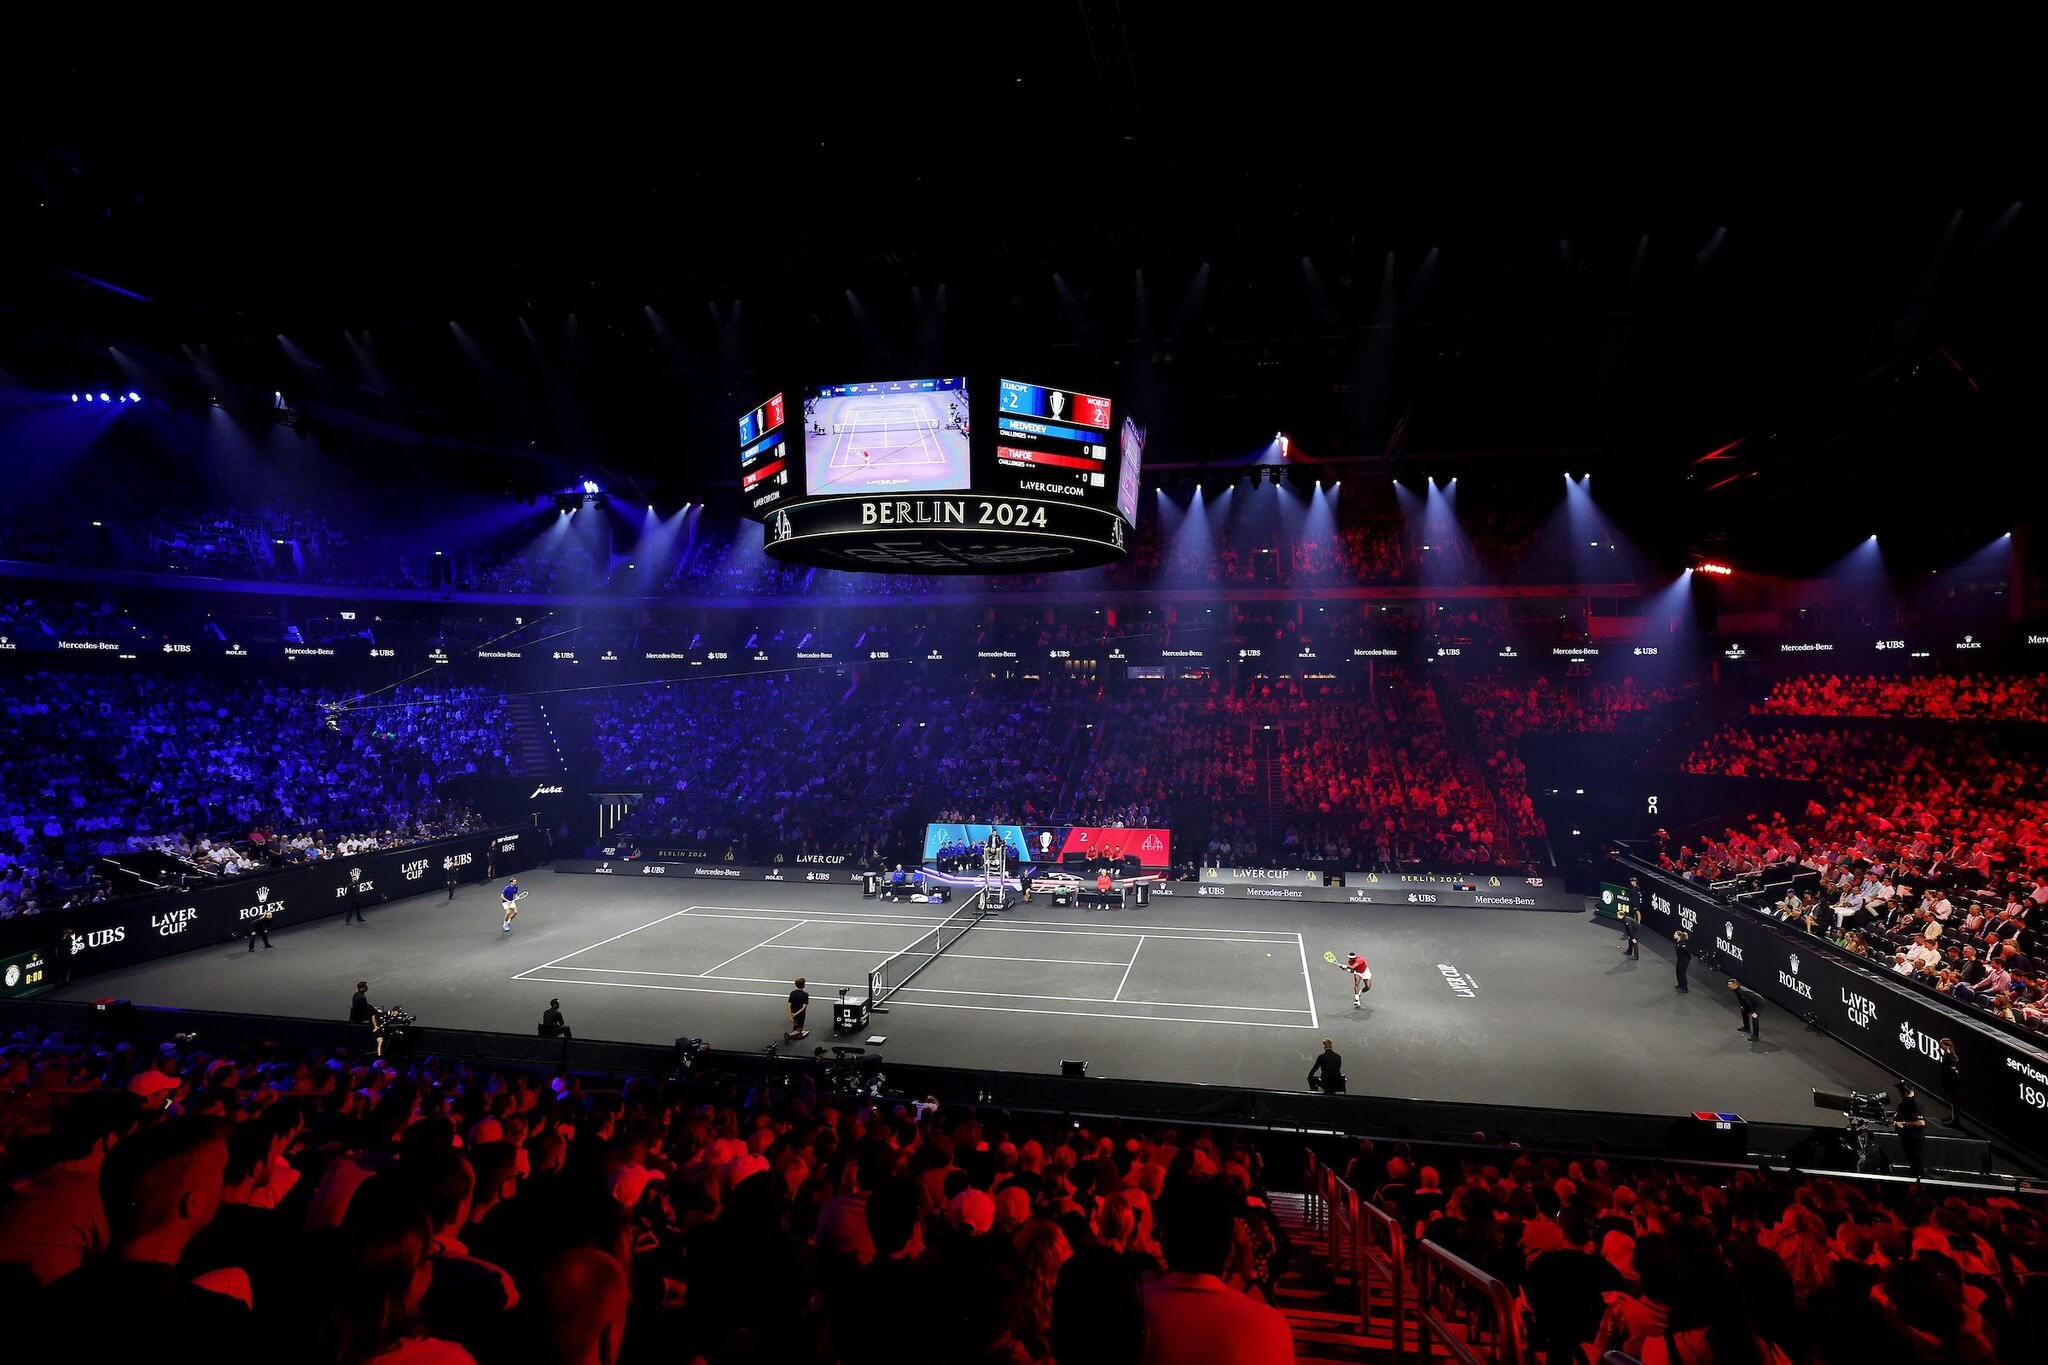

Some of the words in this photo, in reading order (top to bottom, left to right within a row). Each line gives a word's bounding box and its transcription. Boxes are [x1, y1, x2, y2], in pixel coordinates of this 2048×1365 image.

[1002, 382, 1028, 393] EUROPE
[1009, 393, 1019, 408] 2
[1087, 398, 1110, 407] WORLD
[1094, 408, 1102, 422] 2
[1010, 420, 1047, 433] MEDVEDEV
[1008, 449, 1033, 460] TIAFOE
[862, 501, 965, 525] BERLIN
[979, 502, 1048, 528] 2024
[58, 641, 119, 650] Mercedes-Benz
[173, 644, 191, 652] UBS
[1781, 643, 1834, 652] Mercedes-Benz
[1886, 640, 1905, 649] UBS
[284, 647, 334, 655] Mercedes-Benz
[1446, 648, 1460, 656] UBS
[530, 784, 563, 799] jura
[1004, 830, 1012, 840] 2
[1079, 832, 1088, 842] 2
[454, 853, 472, 866] UBS
[796, 854, 824, 864] LAVER
[826, 856, 845, 864] CUP
[402, 859, 429, 873] LAVER
[651, 866, 666, 874] UBS
[694, 868, 740, 877] Mercedes-Benz
[815, 873, 830, 881] UBS
[1233, 869, 1265, 879] LAVER
[1267, 870, 1289, 879] CUP
[336, 881, 374, 897] REX
[1209, 887, 1225, 895] UBS
[1247, 888, 1303, 898] Mercedes-Benz
[1418, 894, 1437, 903] UBS
[1475, 895, 1535, 906] Mercedes-Benz
[240, 901, 285, 920] ROLEX
[1658, 897, 1671, 915] UBS
[152, 908, 198, 928] LAVER
[1678, 904, 1698, 924] LAVER
[88, 926, 125, 948] UBS
[1716, 936, 1743, 961] ROLEX
[26, 959, 44, 969] ROLEX
[1778, 970, 1812, 1000] ROLEX
[1841, 986, 1878, 1020] LAVER
[1917, 1030, 1945, 1063] UB
[2006, 1057, 2048, 1086] servicen
[2019, 1083, 2048, 1109] 189
